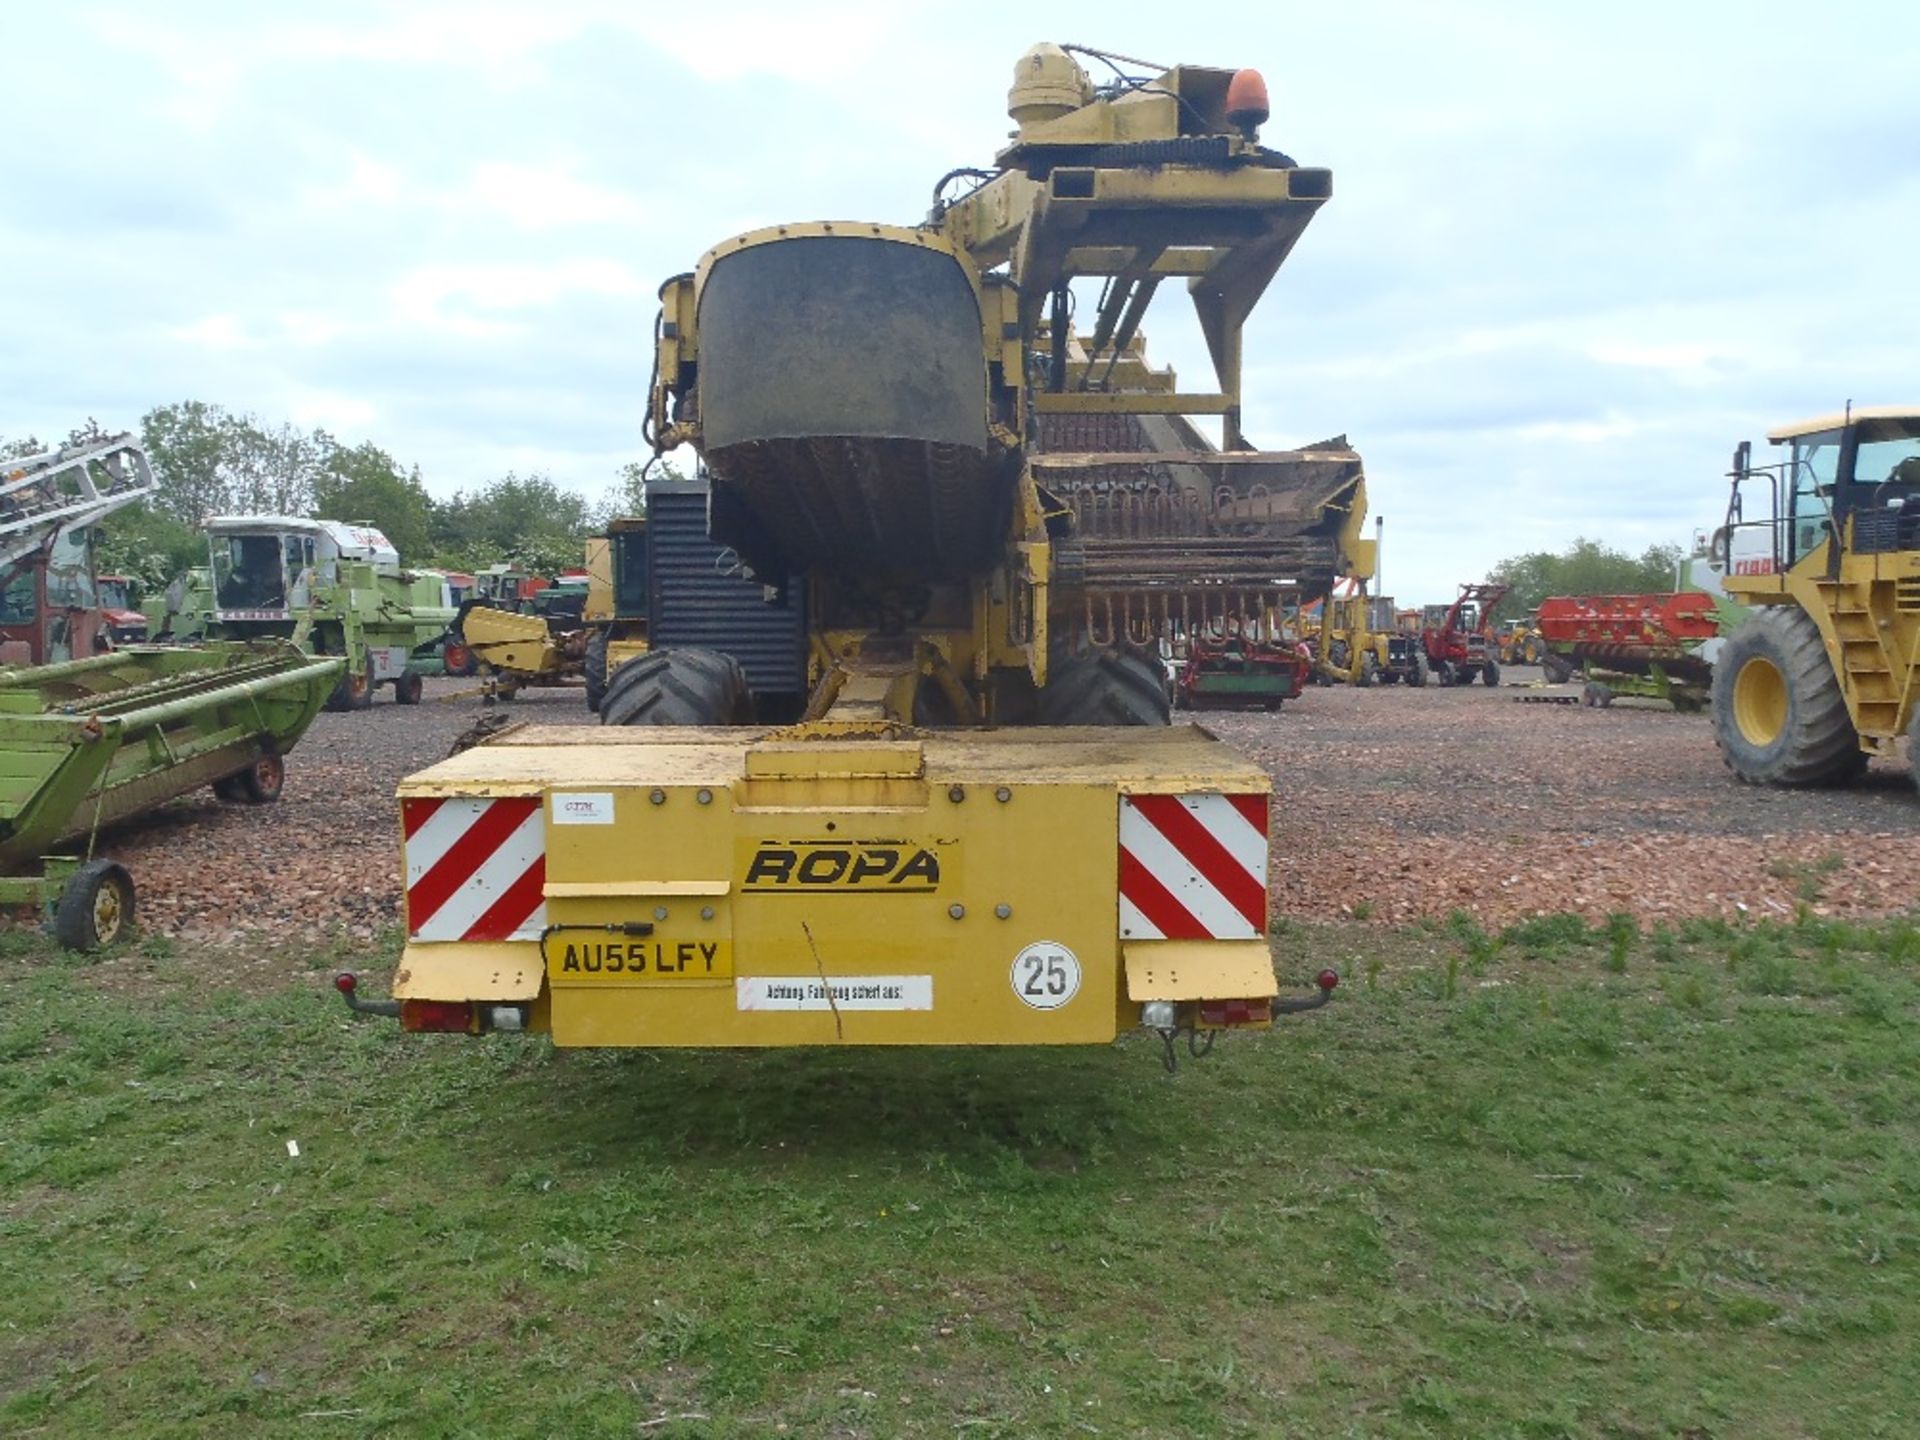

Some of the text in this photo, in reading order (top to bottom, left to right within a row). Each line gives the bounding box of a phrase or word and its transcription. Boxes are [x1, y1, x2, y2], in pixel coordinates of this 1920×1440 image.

[745, 850, 939, 884] ROPA
[563, 943, 717, 972] AU55 LFY
[1024, 956, 1066, 995] 25
